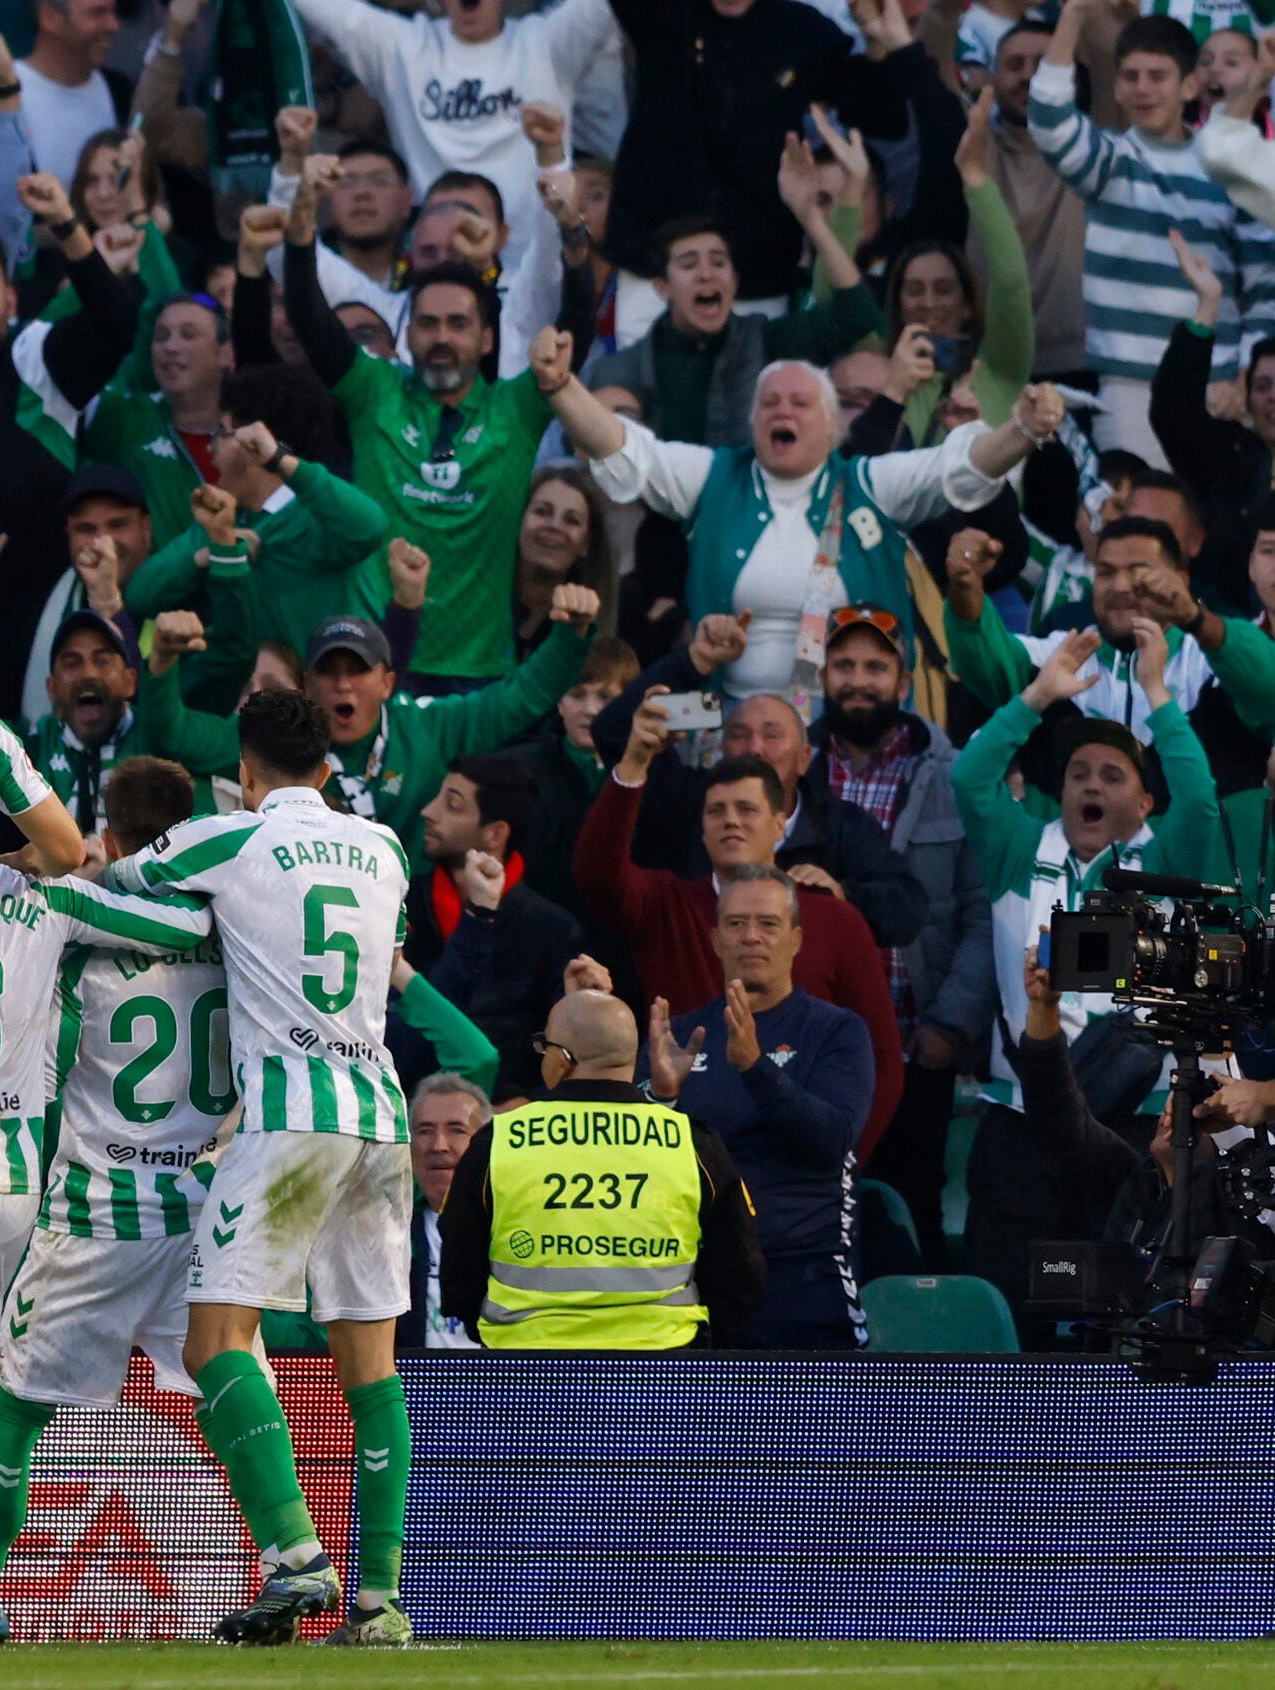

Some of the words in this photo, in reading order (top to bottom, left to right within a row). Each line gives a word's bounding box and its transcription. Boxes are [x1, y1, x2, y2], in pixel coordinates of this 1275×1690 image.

[847, 506, 883, 550] B
[272, 840, 378, 880] BARTRA
[301, 884, 360, 1015] 5
[109, 987, 239, 1124] 20
[508, 1112, 681, 1149] SEGURIDAD
[543, 1173, 648, 1209] 2237
[541, 1235, 679, 1257] PROSEGUR
[1042, 1261, 1076, 1275] SmallRig
